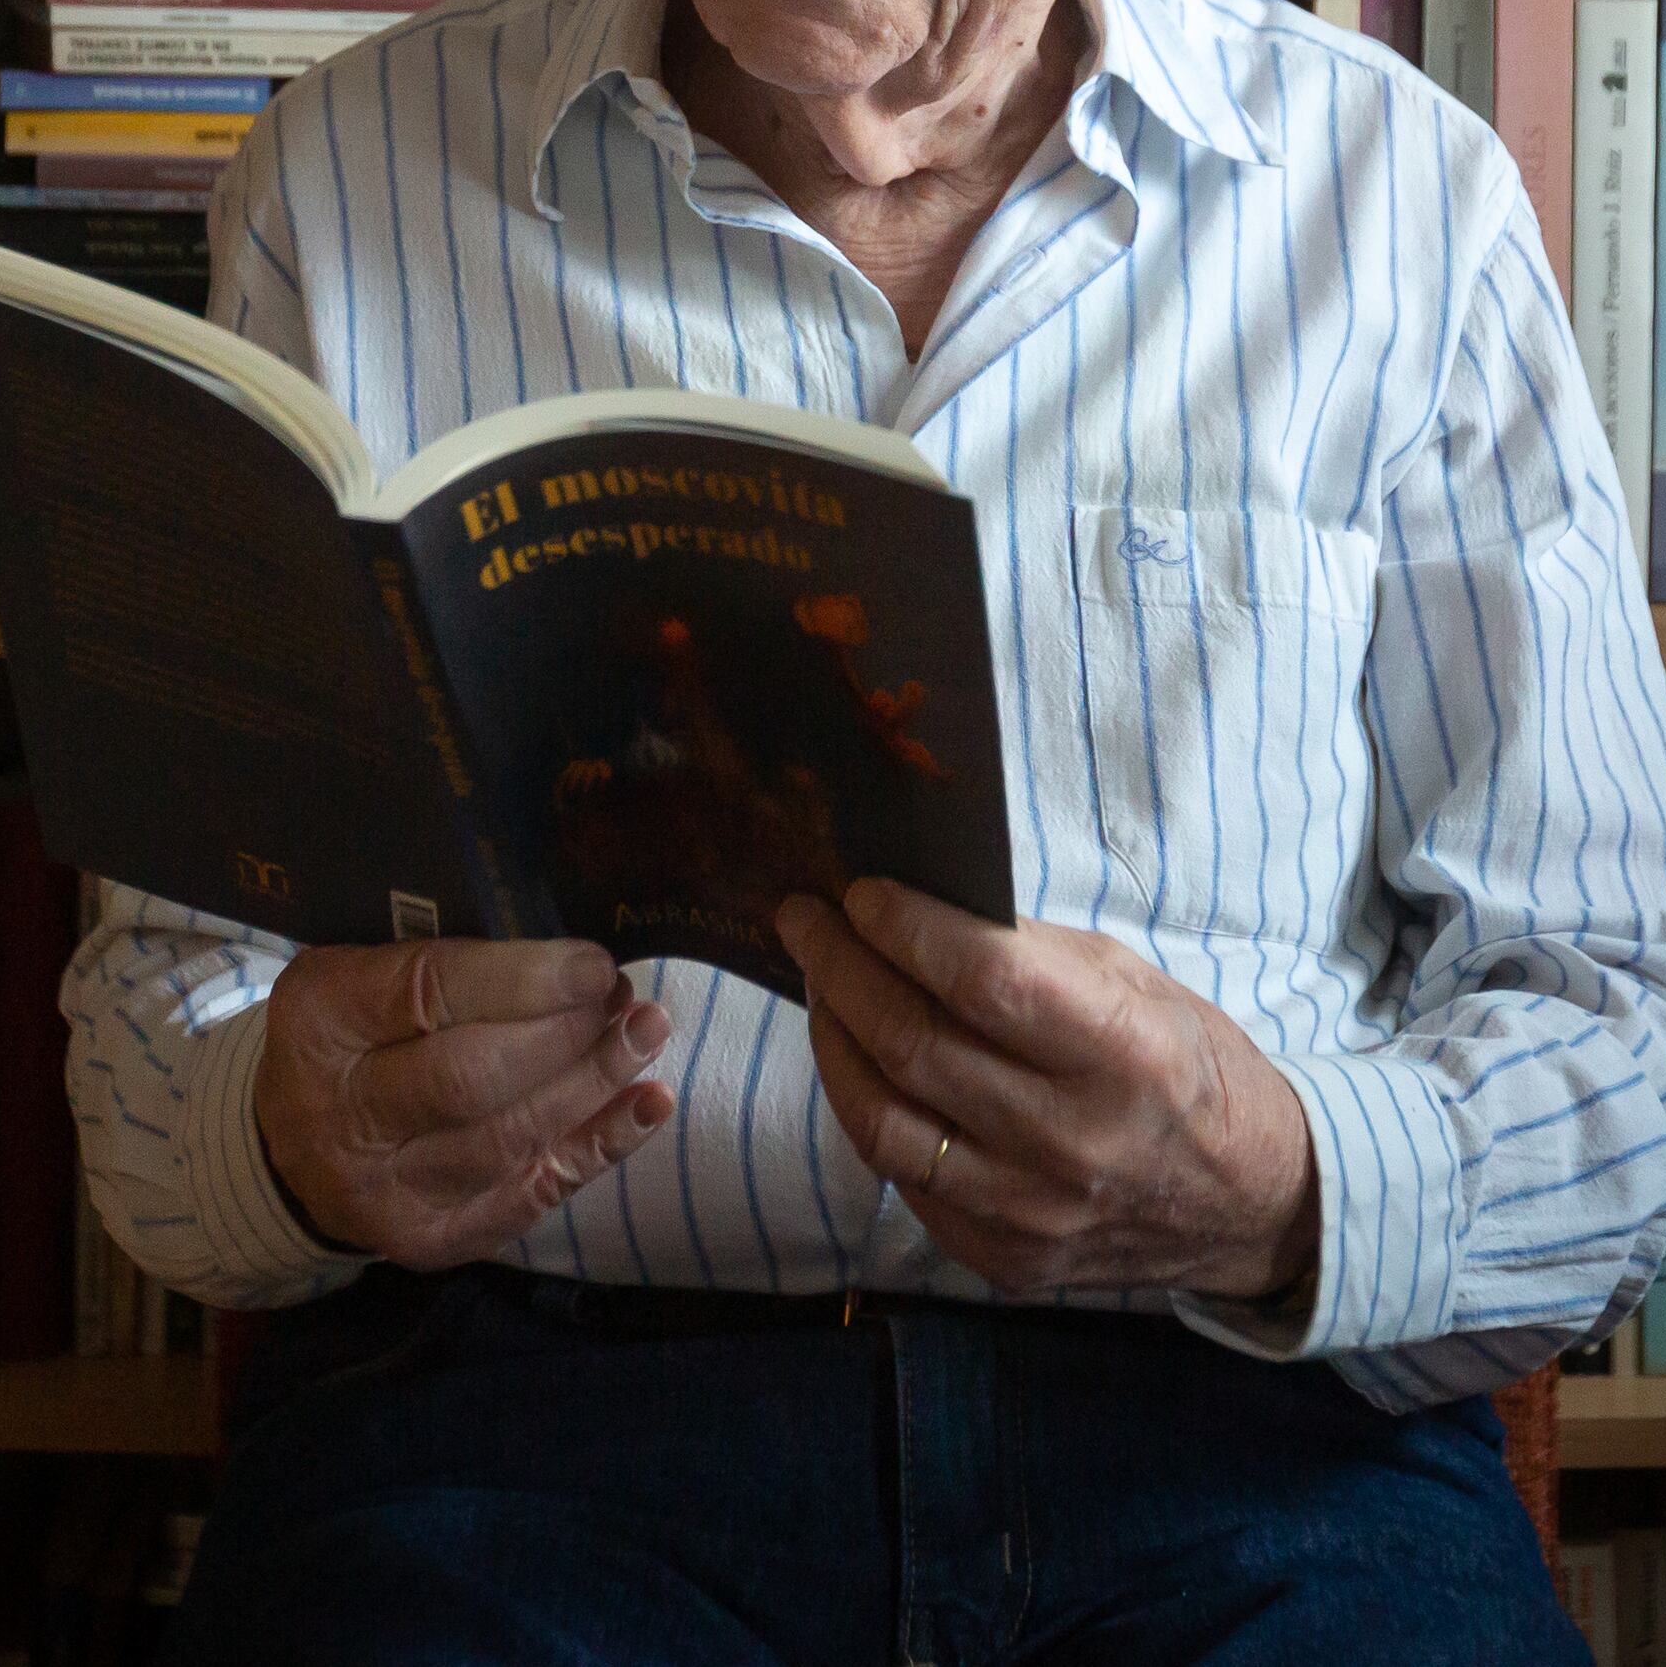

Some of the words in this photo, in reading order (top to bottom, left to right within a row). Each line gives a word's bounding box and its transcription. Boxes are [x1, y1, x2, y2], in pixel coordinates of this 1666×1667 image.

[1599, 219, 1625, 310] Fernando
[459, 480, 519, 543] El
[539, 461, 848, 529] moscovita
[477, 521, 814, 591] desesperado
